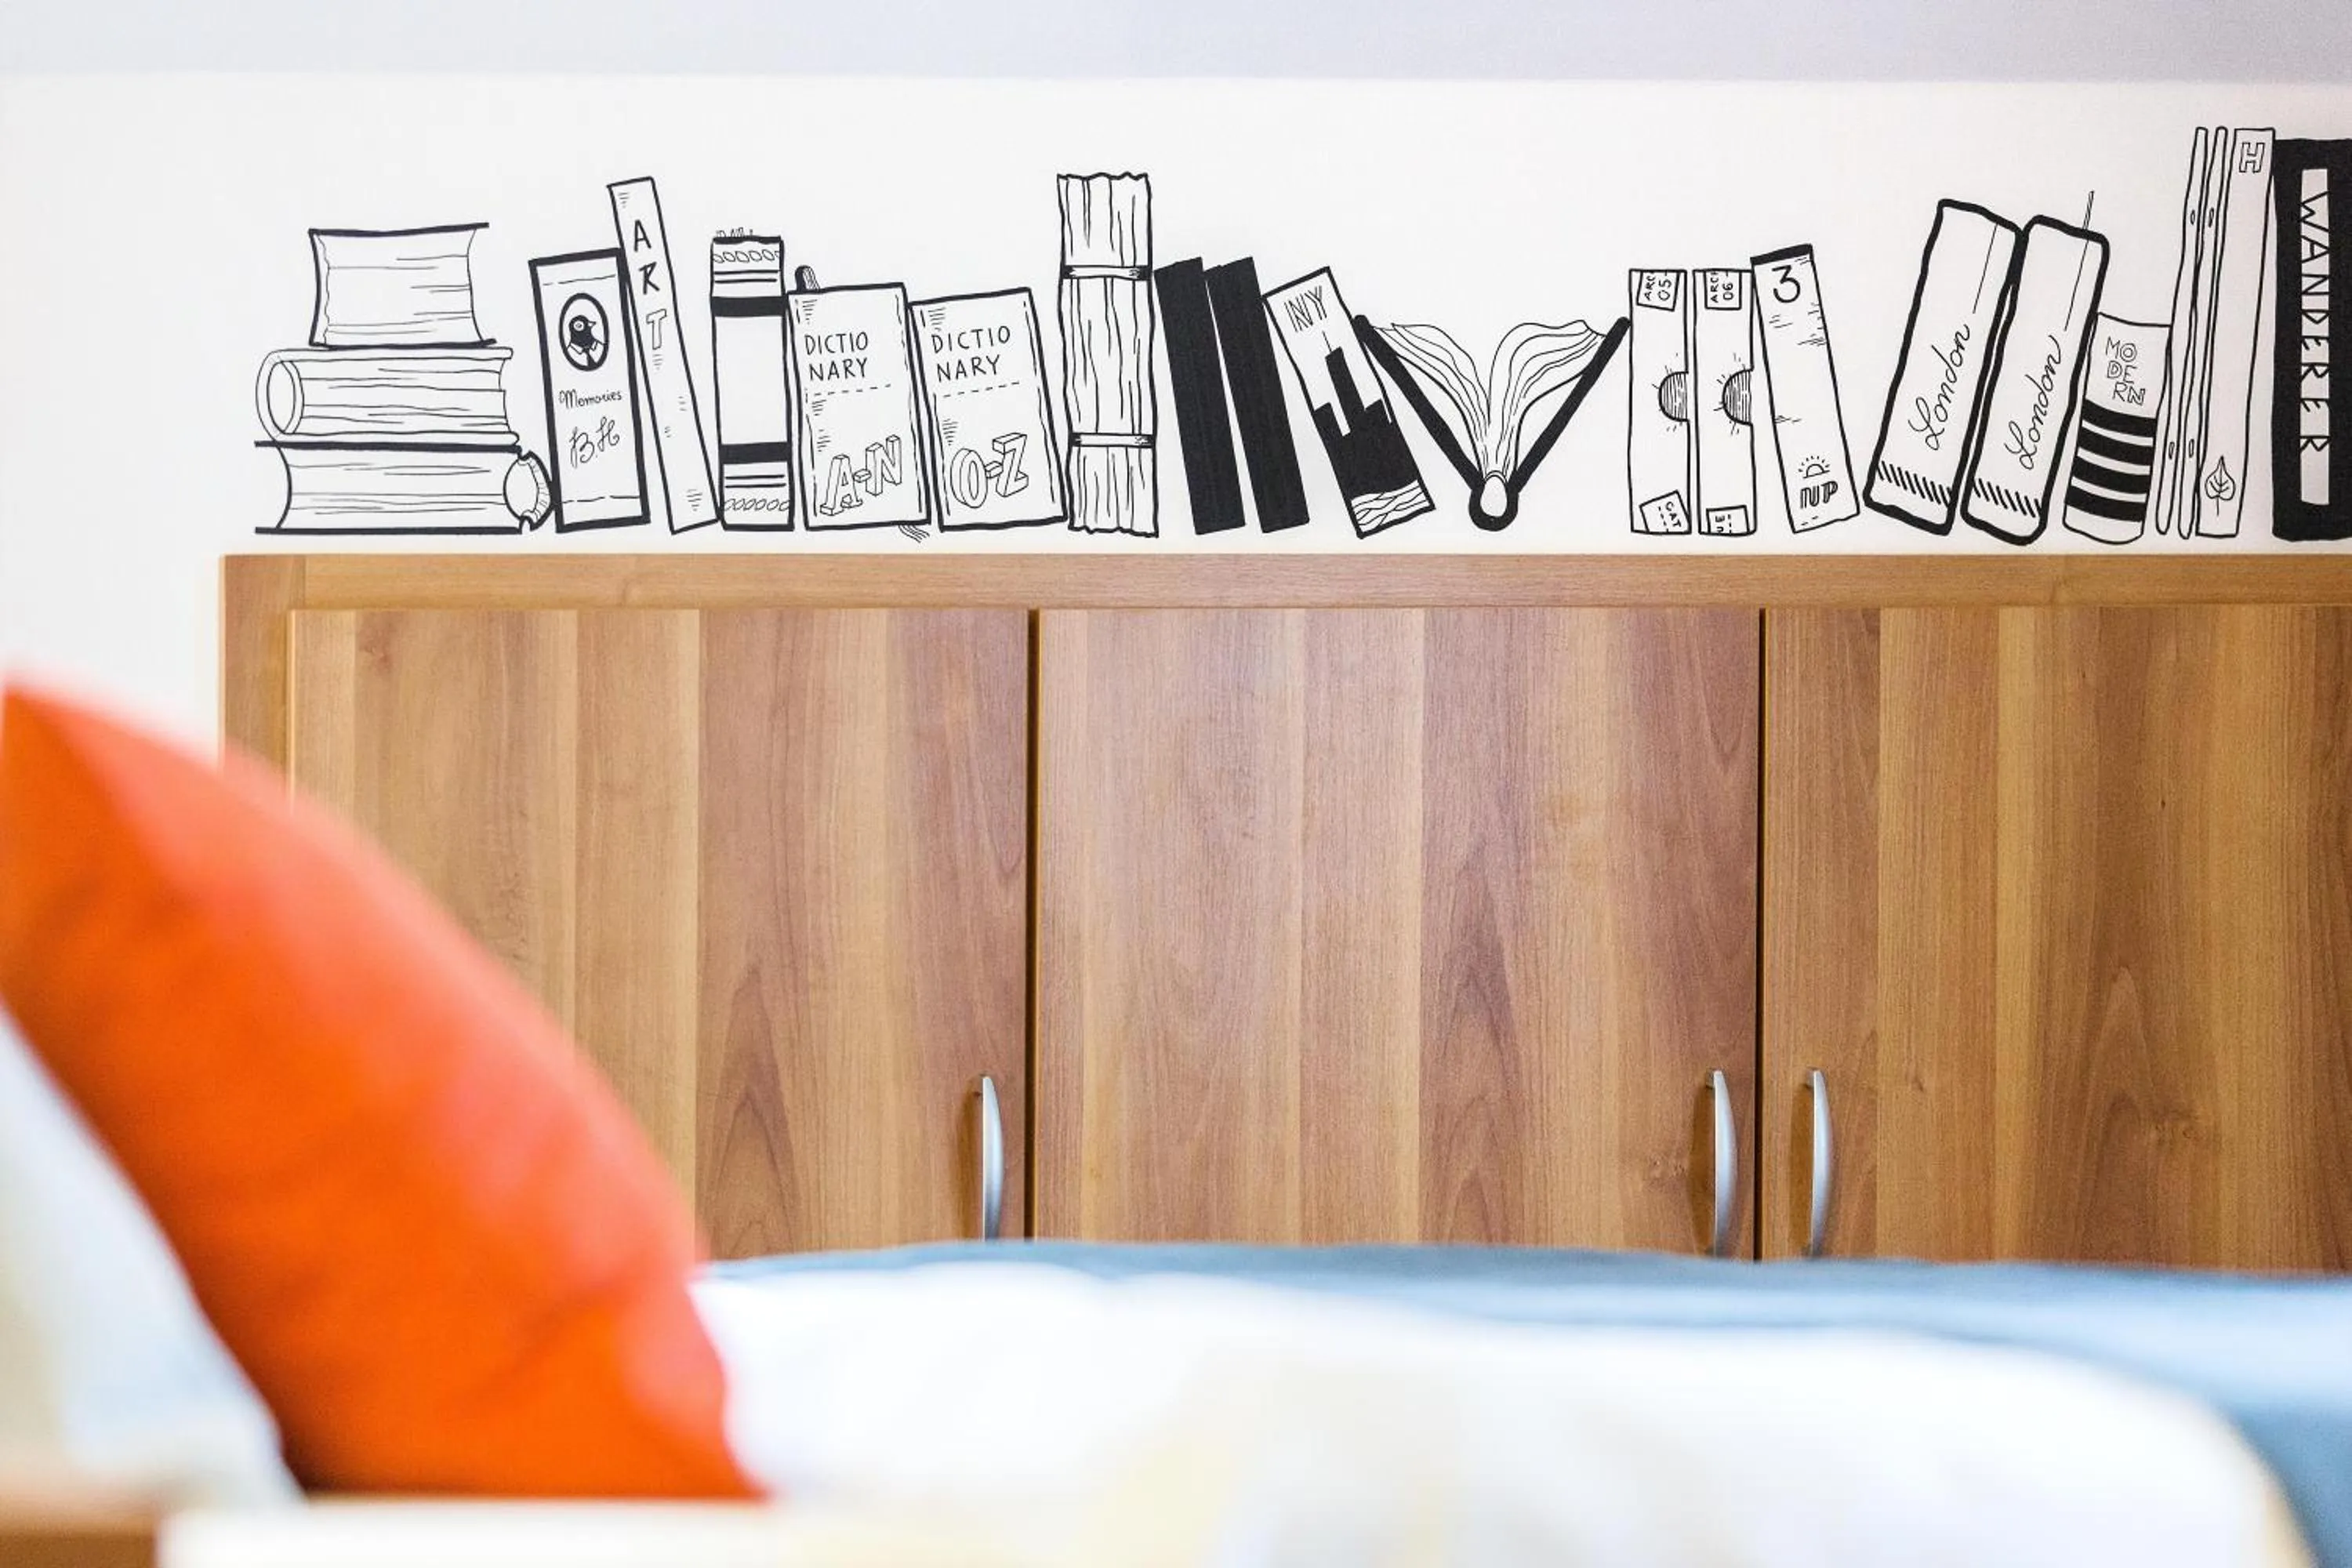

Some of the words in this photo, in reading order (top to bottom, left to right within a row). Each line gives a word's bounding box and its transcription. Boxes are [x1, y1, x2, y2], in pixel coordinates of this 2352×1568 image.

[2238, 142, 2265, 173] H
[633, 219, 667, 350] ART
[1644, 271, 1656, 301] ARC
[1657, 278, 1672, 302] 05
[1722, 281, 1734, 301] 06
[1772, 265, 1801, 303] 3
[2300, 191, 2331, 452] WANDERER
[804, 331, 869, 355] DICTIO
[931, 325, 1011, 354] DICTIO
[809, 357, 868, 382] NARY
[937, 354, 1001, 383] NARY
[1907, 323, 1971, 451] London
[2004, 335, 2062, 470] London
[819, 435, 902, 517] A-N
[949, 432, 1029, 509] O-Z
